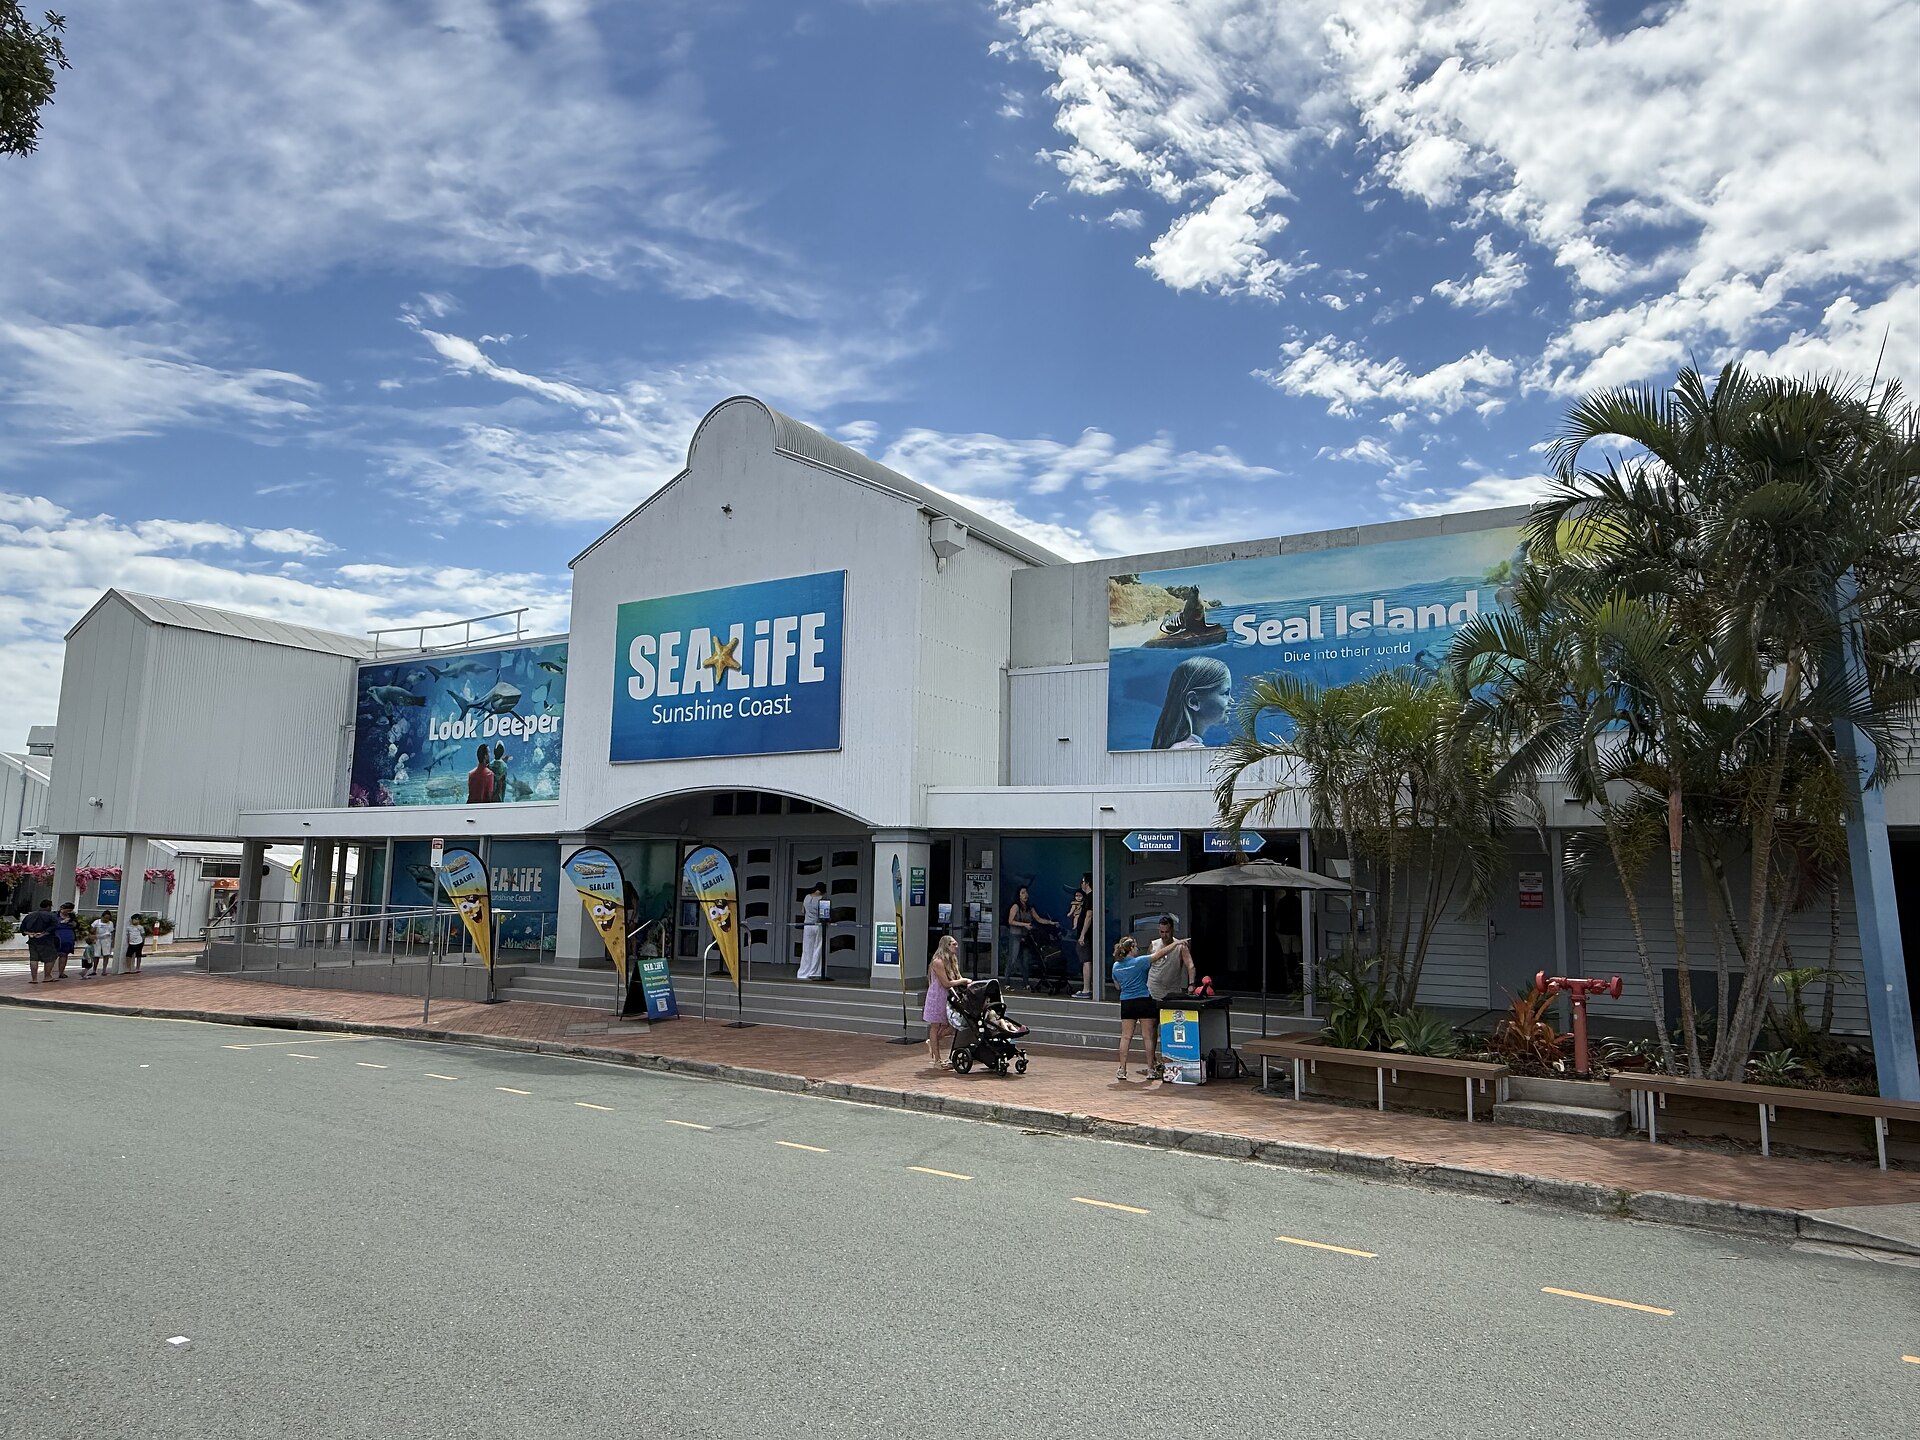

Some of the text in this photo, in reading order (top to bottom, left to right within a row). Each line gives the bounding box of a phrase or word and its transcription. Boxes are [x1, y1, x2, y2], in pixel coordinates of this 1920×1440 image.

[1232, 589, 1479, 648] Seal Island
[628, 627, 714, 700] SEA
[1284, 642, 1411, 663] Dive into their world
[651, 693, 792, 724] Sunshine Coast
[429, 712, 560, 742] Look Deeper
[1137, 833, 1174, 842] Aquarium
[490, 867, 509, 892] EA
